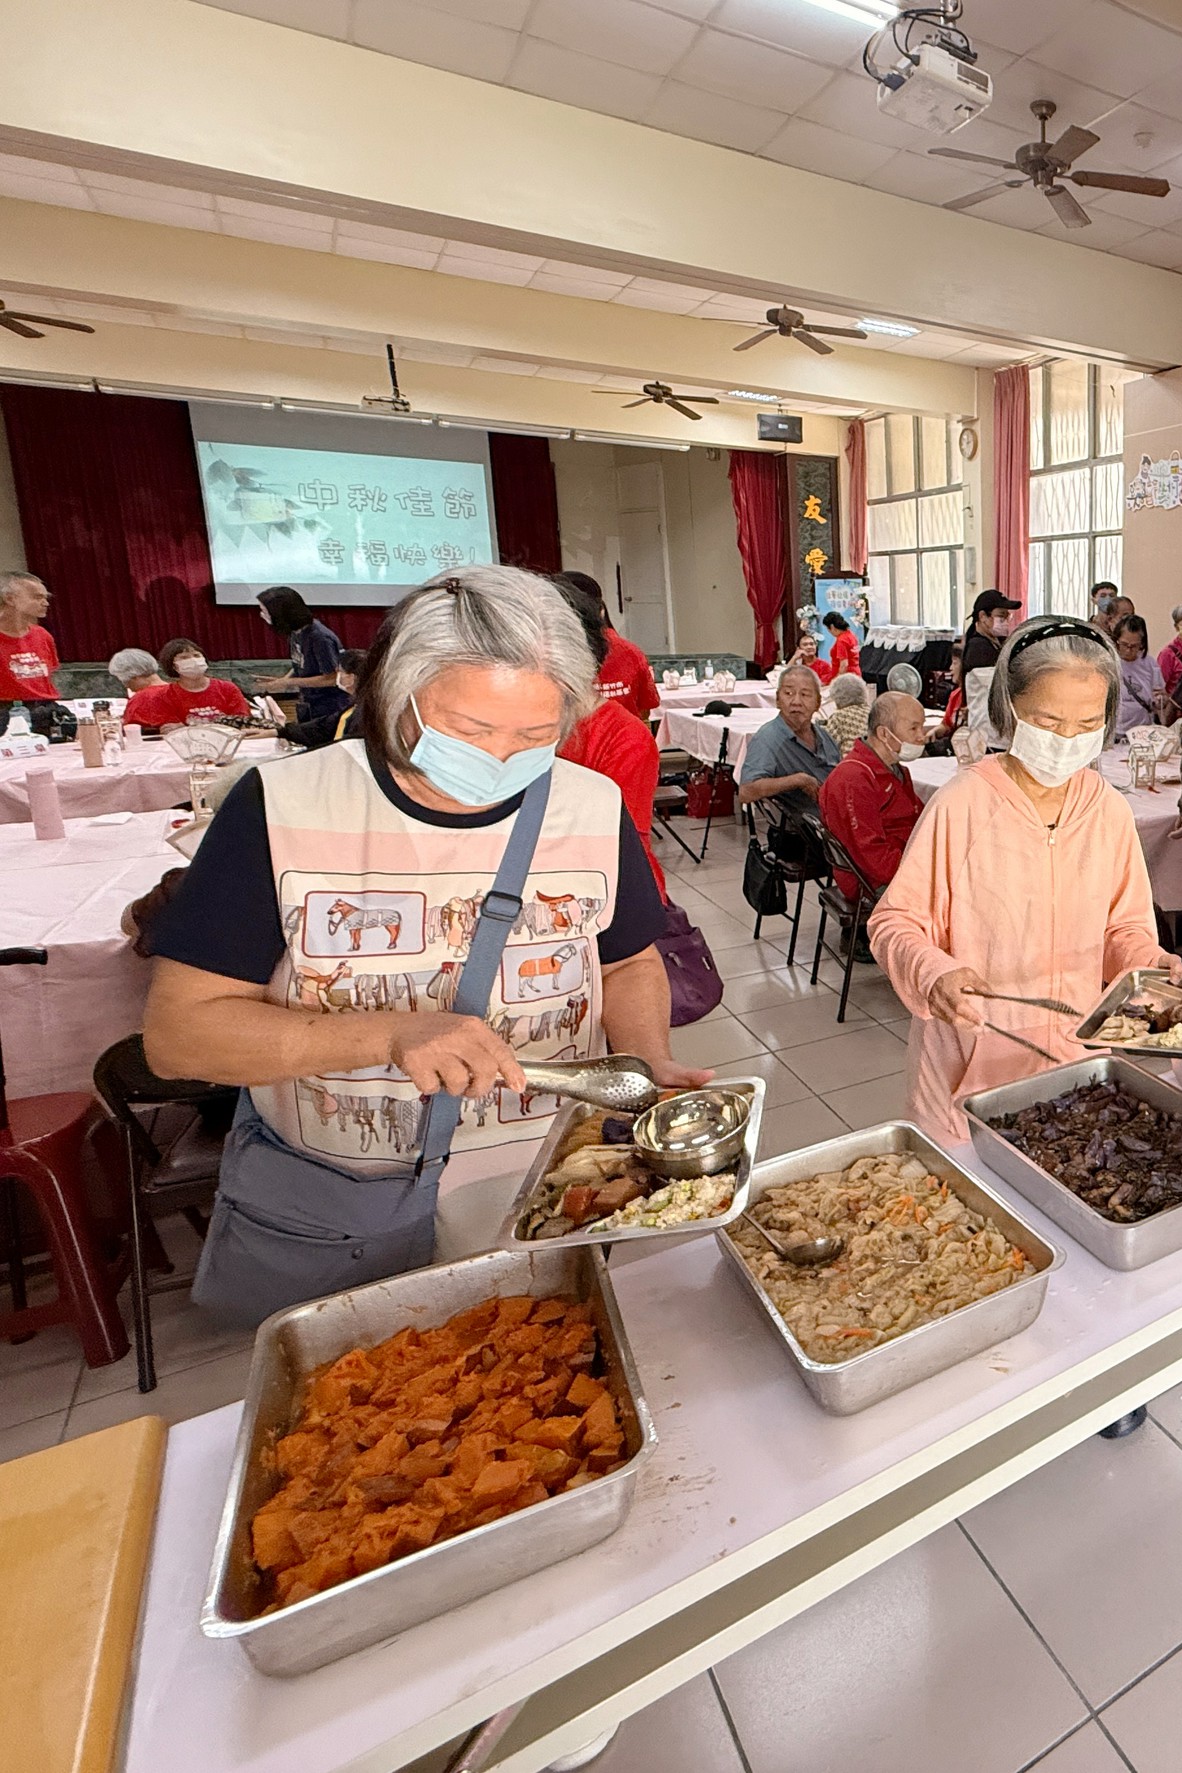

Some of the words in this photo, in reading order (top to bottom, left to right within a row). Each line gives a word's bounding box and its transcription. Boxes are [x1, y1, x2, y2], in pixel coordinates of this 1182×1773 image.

[297, 478, 477, 519] 中秋佳節
[803, 494, 829, 575] 友愛
